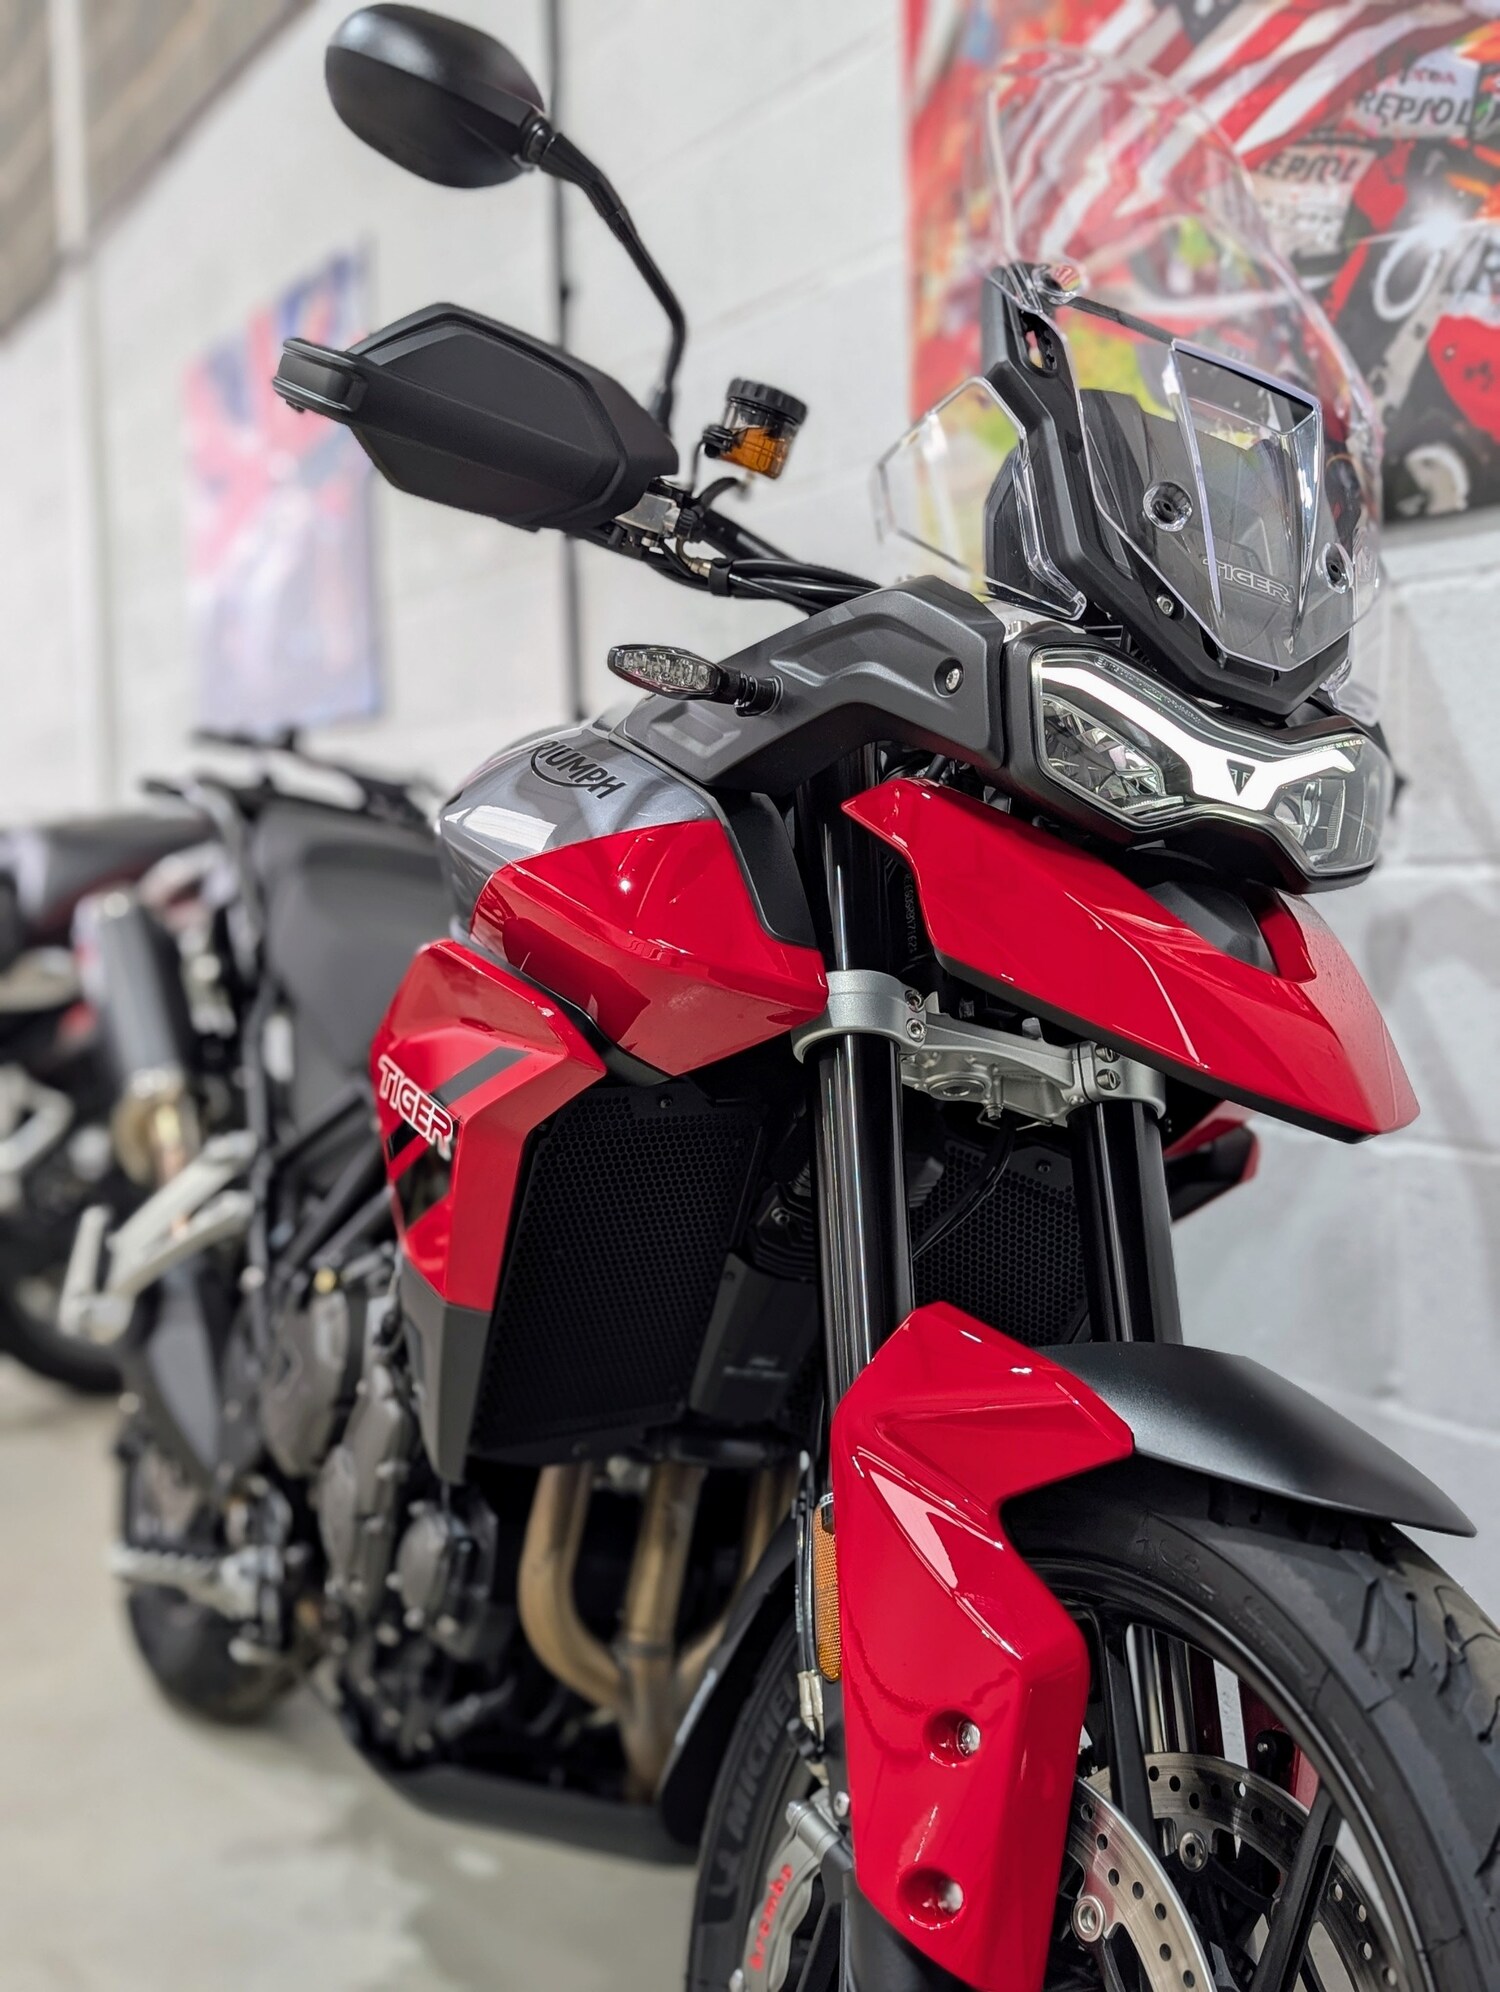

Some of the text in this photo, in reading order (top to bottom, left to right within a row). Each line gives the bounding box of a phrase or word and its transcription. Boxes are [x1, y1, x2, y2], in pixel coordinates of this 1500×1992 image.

[1203, 558, 1292, 604] TIGER
[529, 740, 627, 800] RIUMPH
[377, 1053, 454, 1161] TIGER
[749, 1863, 793, 1971] brembo
